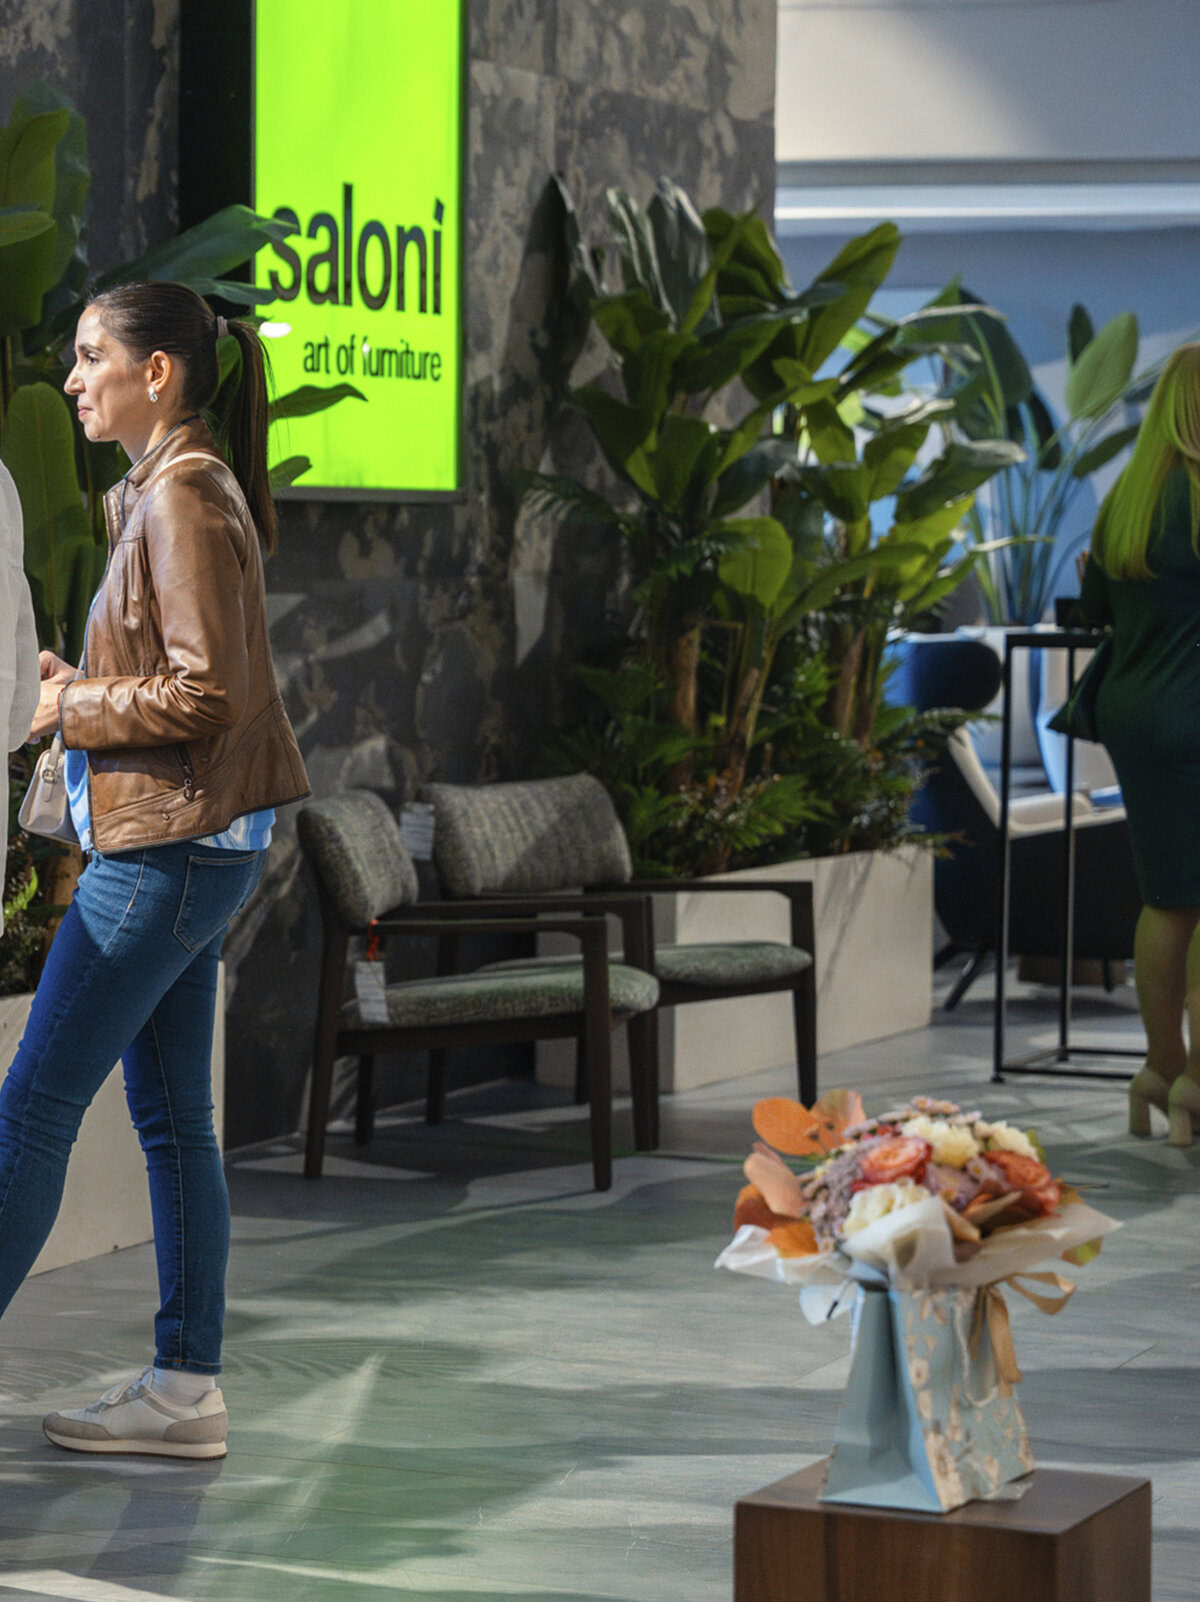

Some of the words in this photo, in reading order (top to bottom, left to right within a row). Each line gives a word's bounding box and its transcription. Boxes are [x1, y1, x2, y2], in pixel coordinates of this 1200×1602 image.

[268, 182, 444, 316] saloni
[303, 335, 330, 375] art
[336, 333, 356, 376] of
[361, 335, 443, 382] furniture
